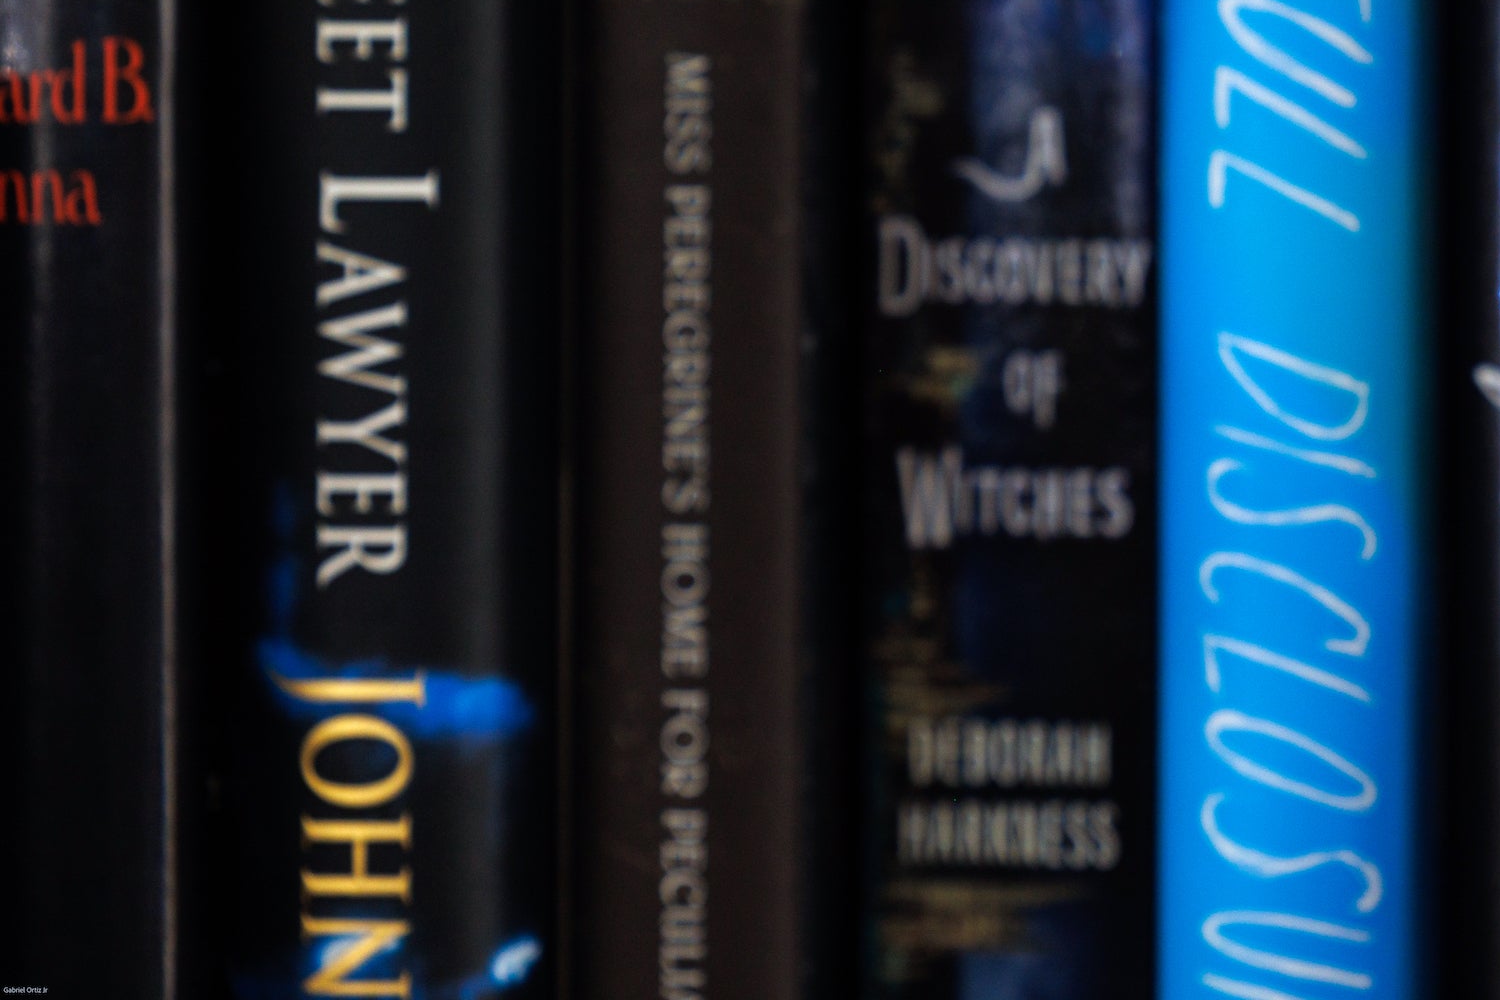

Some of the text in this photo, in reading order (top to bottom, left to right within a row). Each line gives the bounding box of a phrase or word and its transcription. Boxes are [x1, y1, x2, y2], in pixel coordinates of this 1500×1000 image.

[664, 52, 712, 175] MISS
[316, 168, 441, 588] LAWYER
[661, 183, 712, 515] PEREGRINE'S
[660, 521, 711, 680] HOME
[1199, 332, 1384, 1000] DISCLOSU
[659, 687, 710, 800] FOR
[906, 717, 1112, 788] DEBORAH
[266, 667, 425, 1000] JOHN
[897, 800, 1120, 869] HARKNESS
